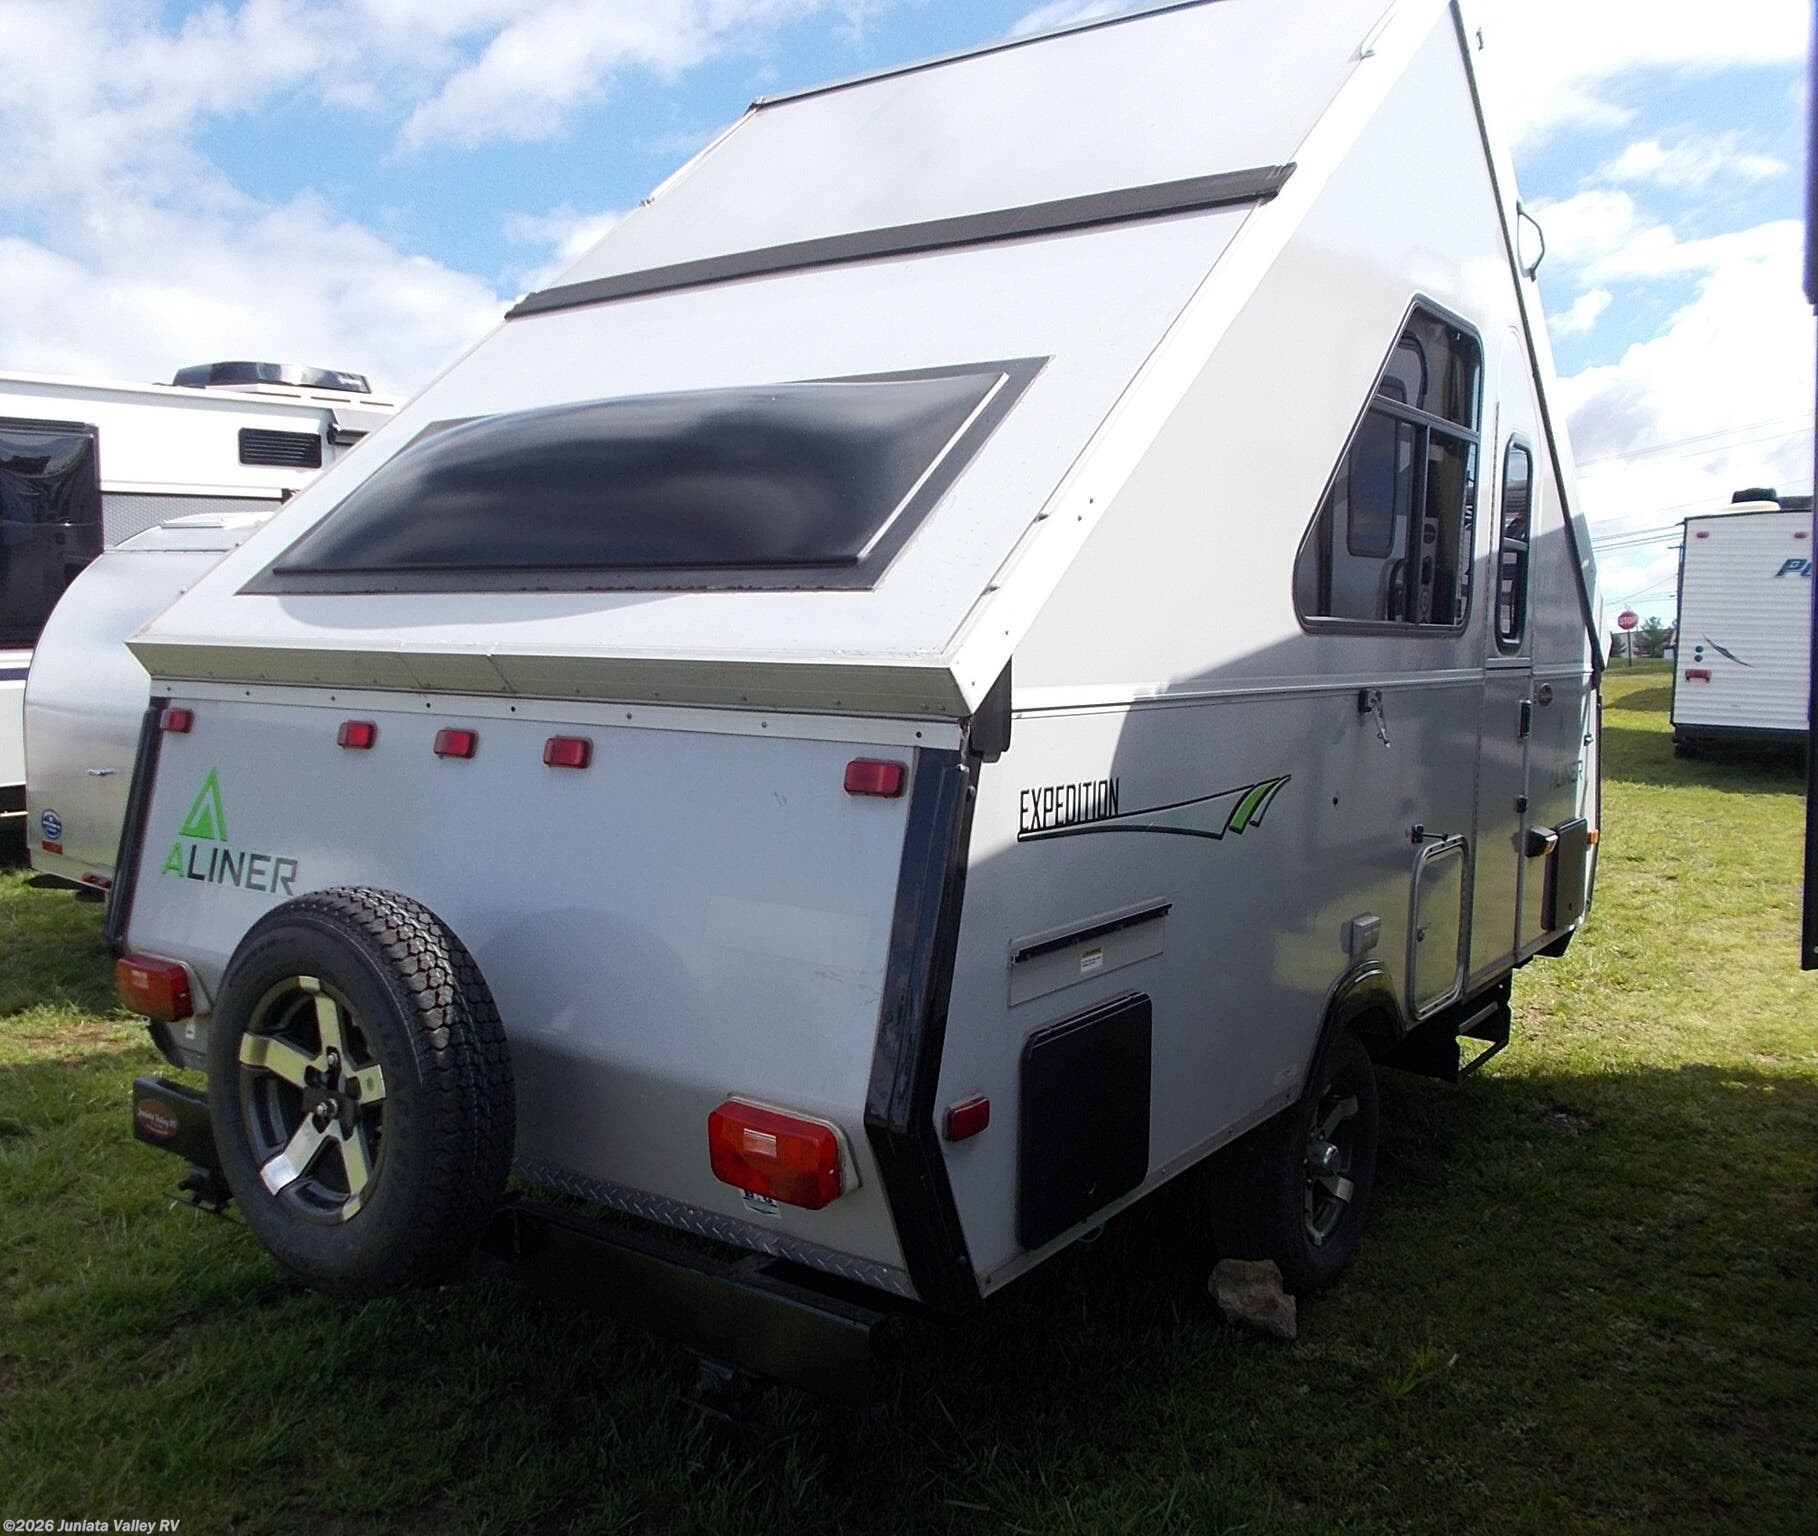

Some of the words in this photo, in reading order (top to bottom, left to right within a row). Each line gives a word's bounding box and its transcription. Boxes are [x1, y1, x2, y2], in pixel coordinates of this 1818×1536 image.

[1619, 616, 1637, 626] STOP
[1019, 777, 1119, 834] EXPEDITION
[161, 841, 298, 897] ALINER
